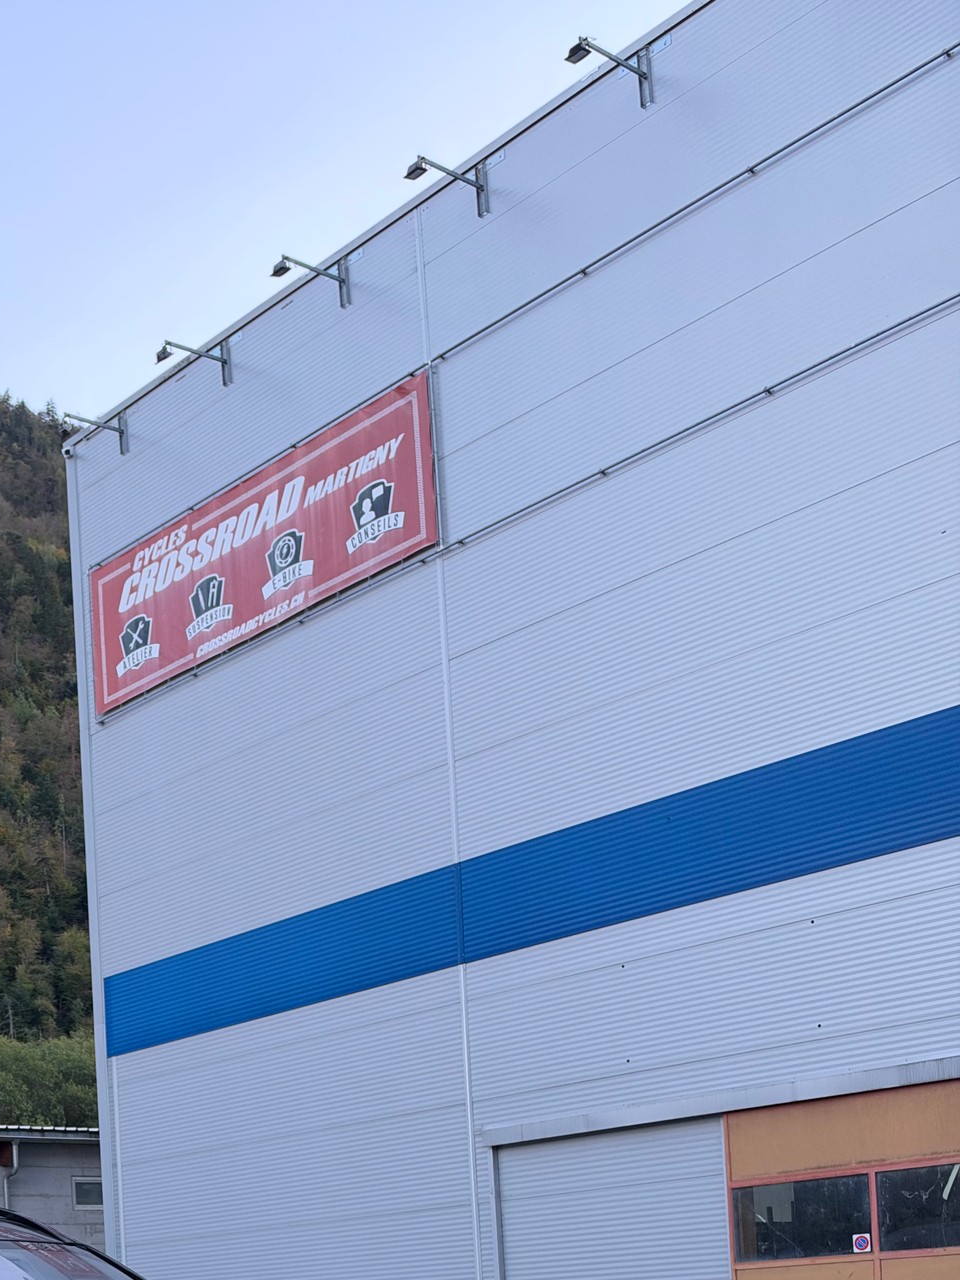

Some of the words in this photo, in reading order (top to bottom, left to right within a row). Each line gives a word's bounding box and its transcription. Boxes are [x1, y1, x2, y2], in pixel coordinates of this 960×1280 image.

[118, 475, 305, 613] CROSSROAD
[303, 433, 406, 509] MARTIGNY
[350, 513, 399, 547] CONSEILS
[132, 524, 187, 572] CYCLES
[271, 563, 303, 591] E-BIKE
[187, 608, 232, 638] SUSPENSION
[195, 590, 305, 658] CROSSROADCYCLES.CH
[122, 646, 153, 671] ATELIER
